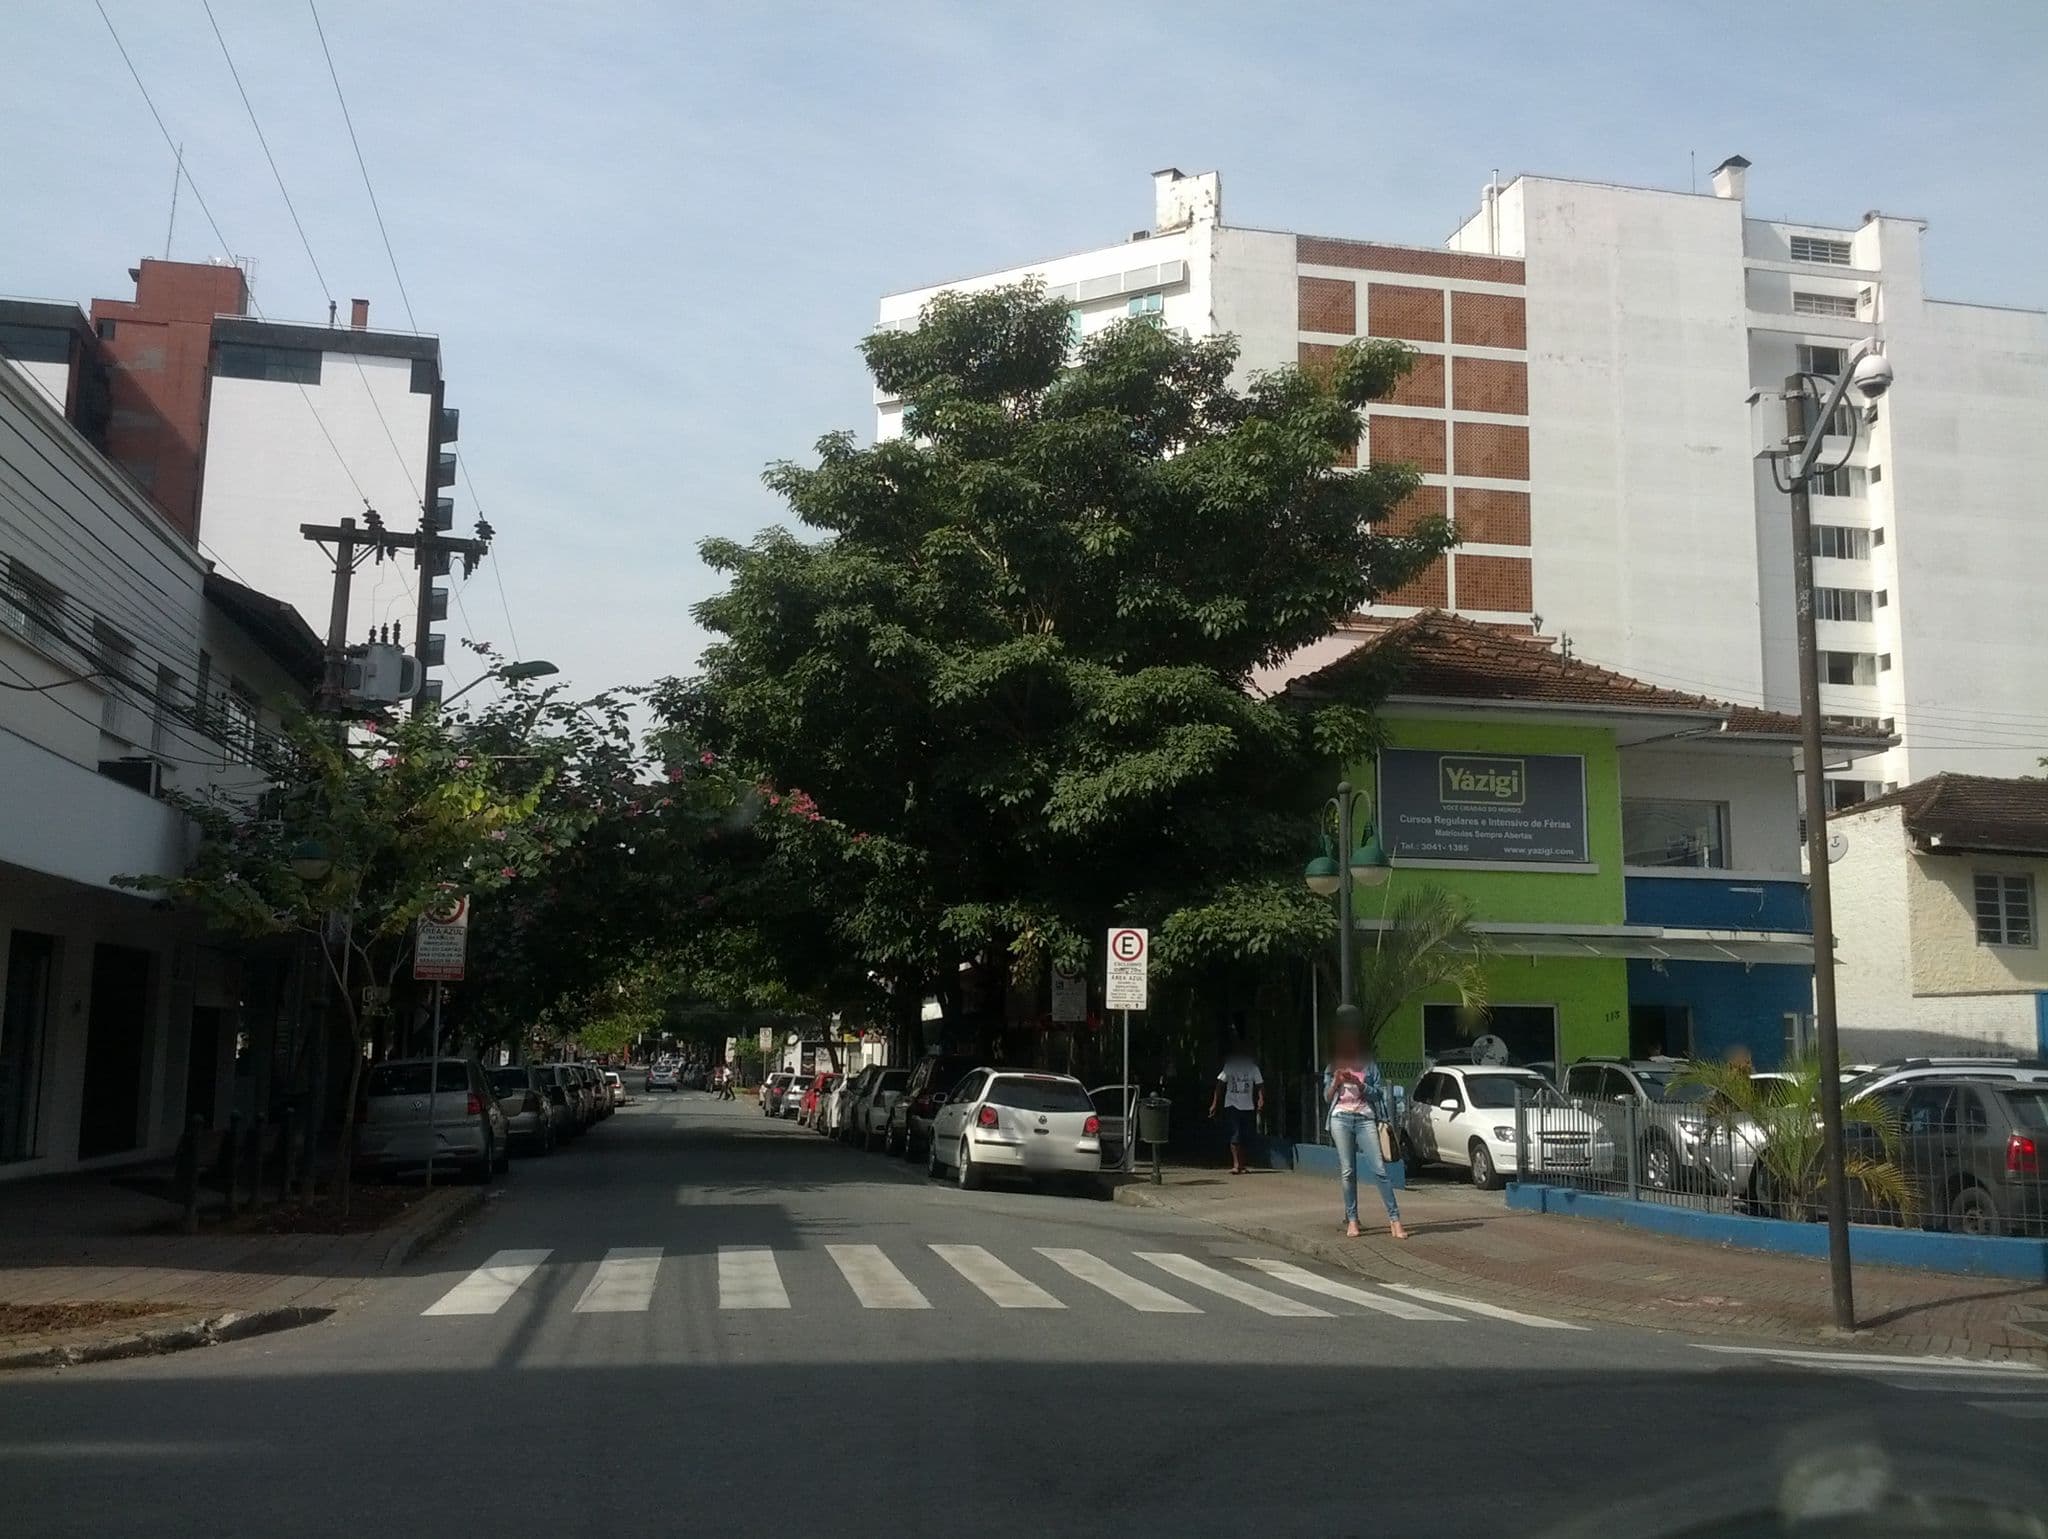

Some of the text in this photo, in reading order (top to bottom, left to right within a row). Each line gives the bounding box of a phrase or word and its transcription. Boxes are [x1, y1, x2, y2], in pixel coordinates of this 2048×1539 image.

[1400, 814, 1571, 829] Cursos Regulares e Intensivo de Férias
[1474, 829, 1502, 840] Sempre
[1504, 830, 1532, 840] Abertas
[1503, 846, 1574, 857] www.yazigi.com
[1122, 936, 1134, 954] E
